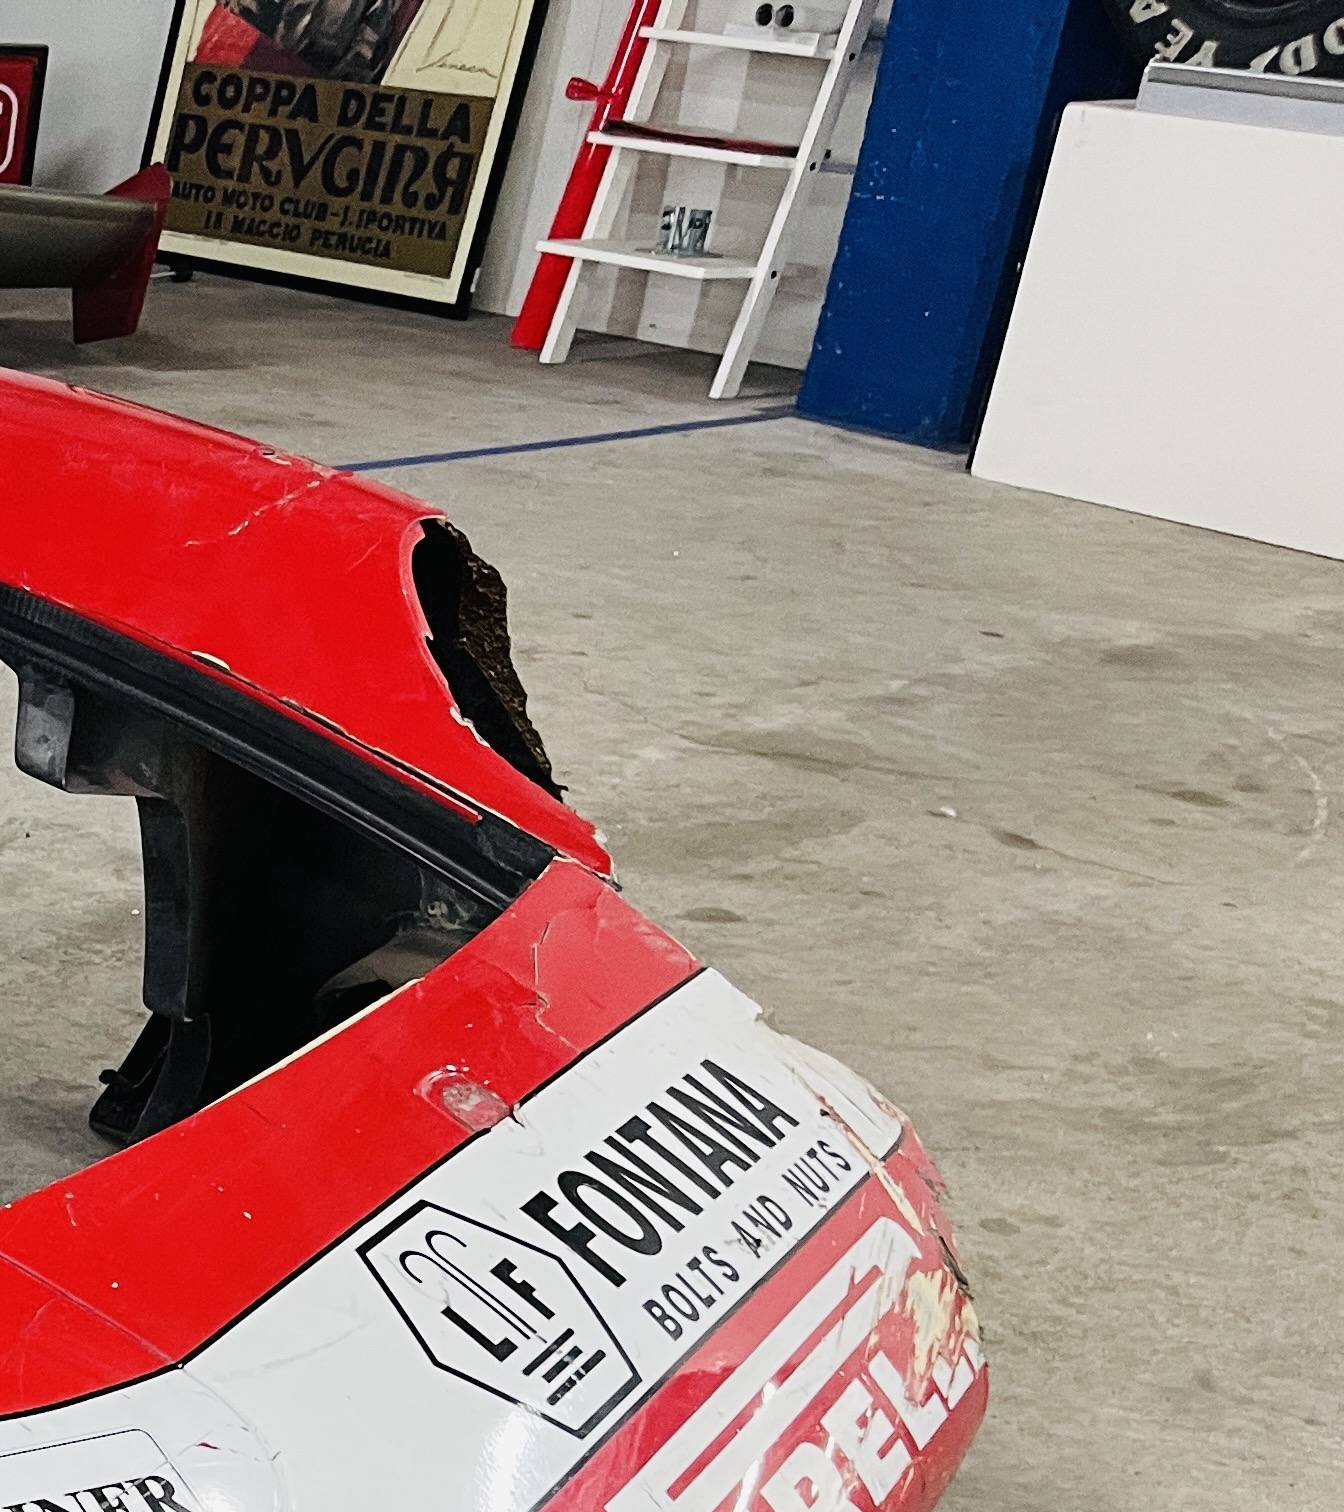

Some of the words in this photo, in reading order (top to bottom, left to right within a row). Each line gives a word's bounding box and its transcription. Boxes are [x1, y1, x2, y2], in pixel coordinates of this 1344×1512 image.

[192, 70, 319, 123] COPPA
[337, 88, 471, 144] DELLA
[171, 180, 216, 204] AUTO
[222, 187, 274, 213] MOTO
[308, 228, 393, 259] PERUGIA
[519, 1059, 799, 1287] FONTANA
[642, 1245, 740, 1341] BOLTS
[731, 1195, 793, 1259] AND
[781, 1140, 852, 1208] NUTS
